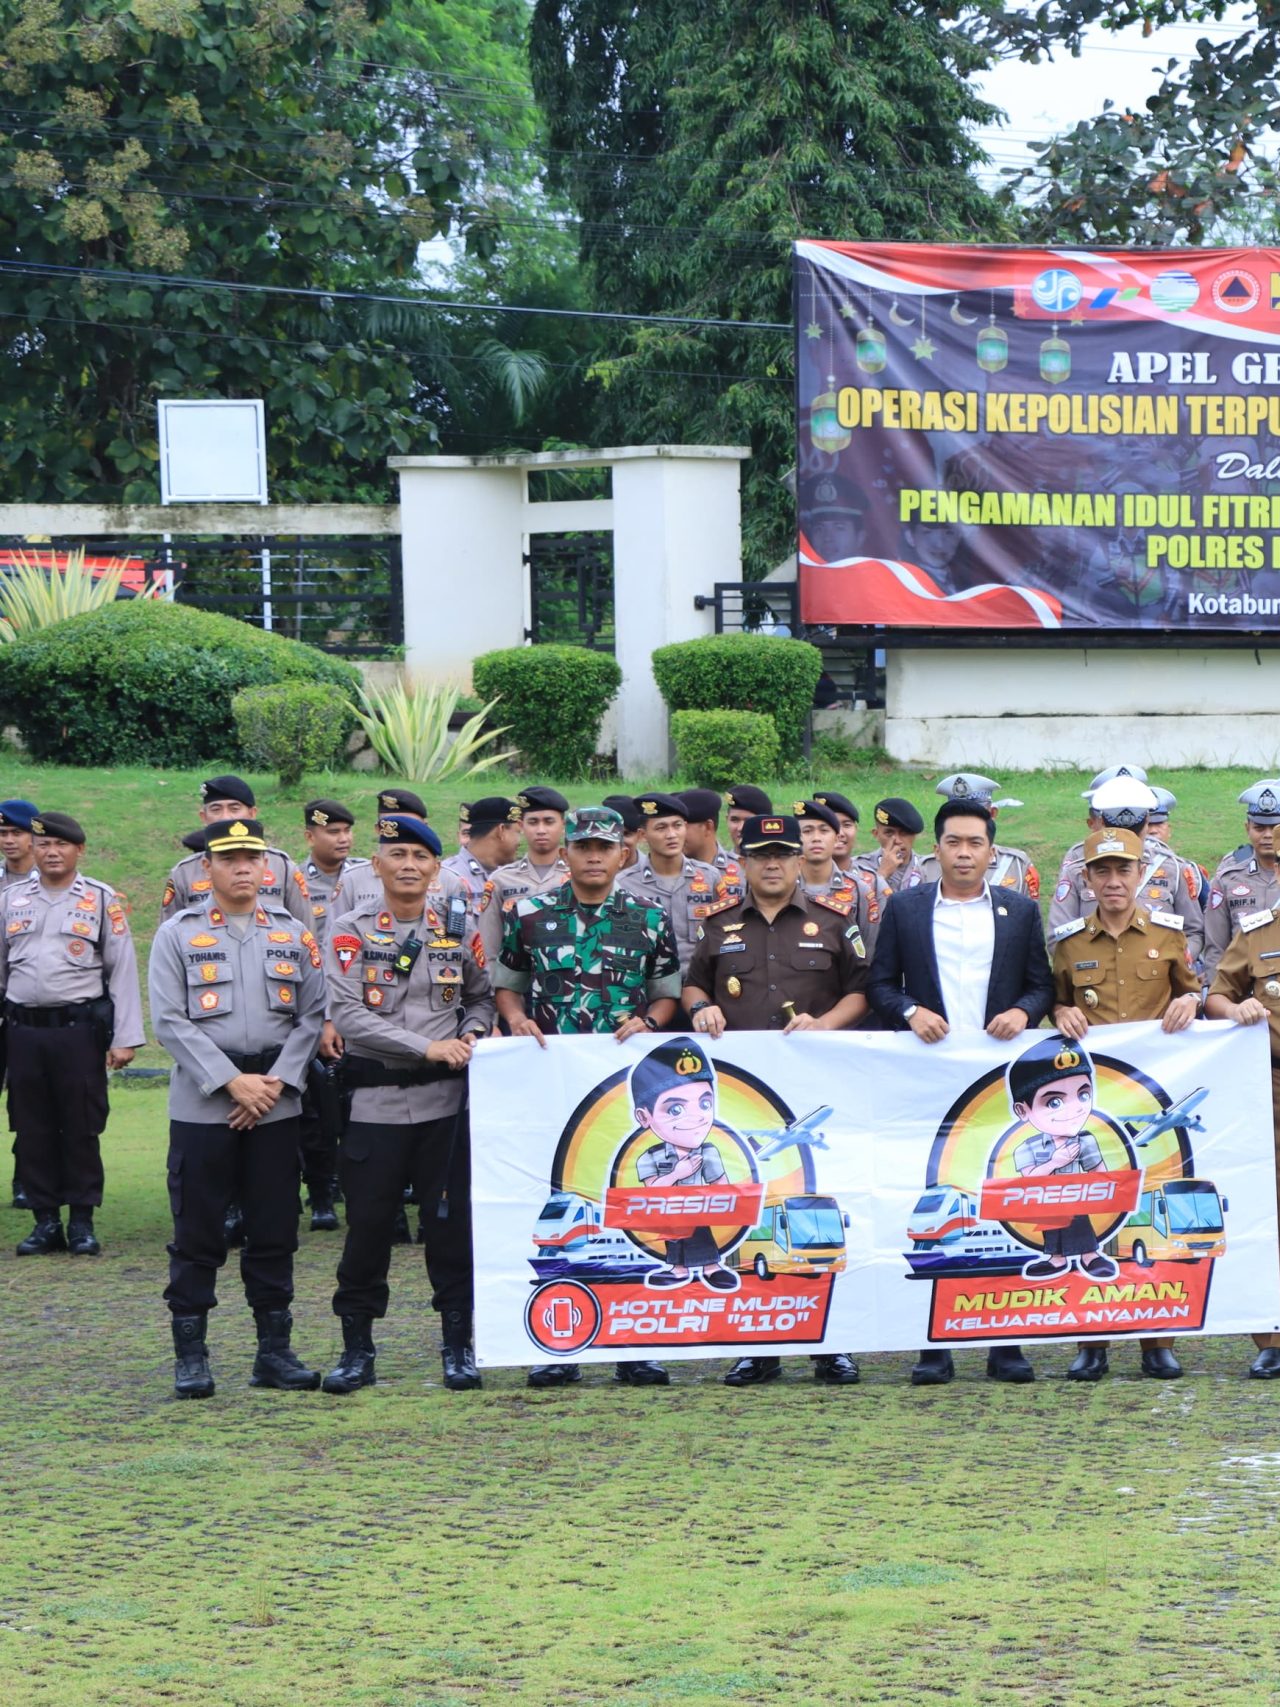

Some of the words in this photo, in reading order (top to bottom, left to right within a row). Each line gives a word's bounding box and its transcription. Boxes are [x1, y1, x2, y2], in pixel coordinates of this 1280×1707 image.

[1107, 351, 1217, 385] APEL
[837, 387, 978, 431] OPERASI
[986, 394, 1178, 434] KEPOLISIAN
[900, 489, 1116, 527] PENGAMANAN
[1124, 495, 1196, 528] IDUL
[1147, 535, 1265, 569] POLRES
[266, 949, 300, 961] POLRI
[428, 951, 463, 963] POLRI
[626, 1194, 736, 1215] PRESISI
[1003, 1180, 1119, 1206] PRESISI
[608, 1298, 725, 1316] HOTLINE
[732, 1295, 820, 1312] MUDIK
[953, 1285, 1067, 1313] MUDIK
[1080, 1281, 1189, 1305] AMAN,
[608, 1316, 709, 1335] POLRI
[727, 1312, 810, 1332] "110"
[944, 1311, 1078, 1331] KELUARGA
[1085, 1305, 1190, 1324] NYAMAN
